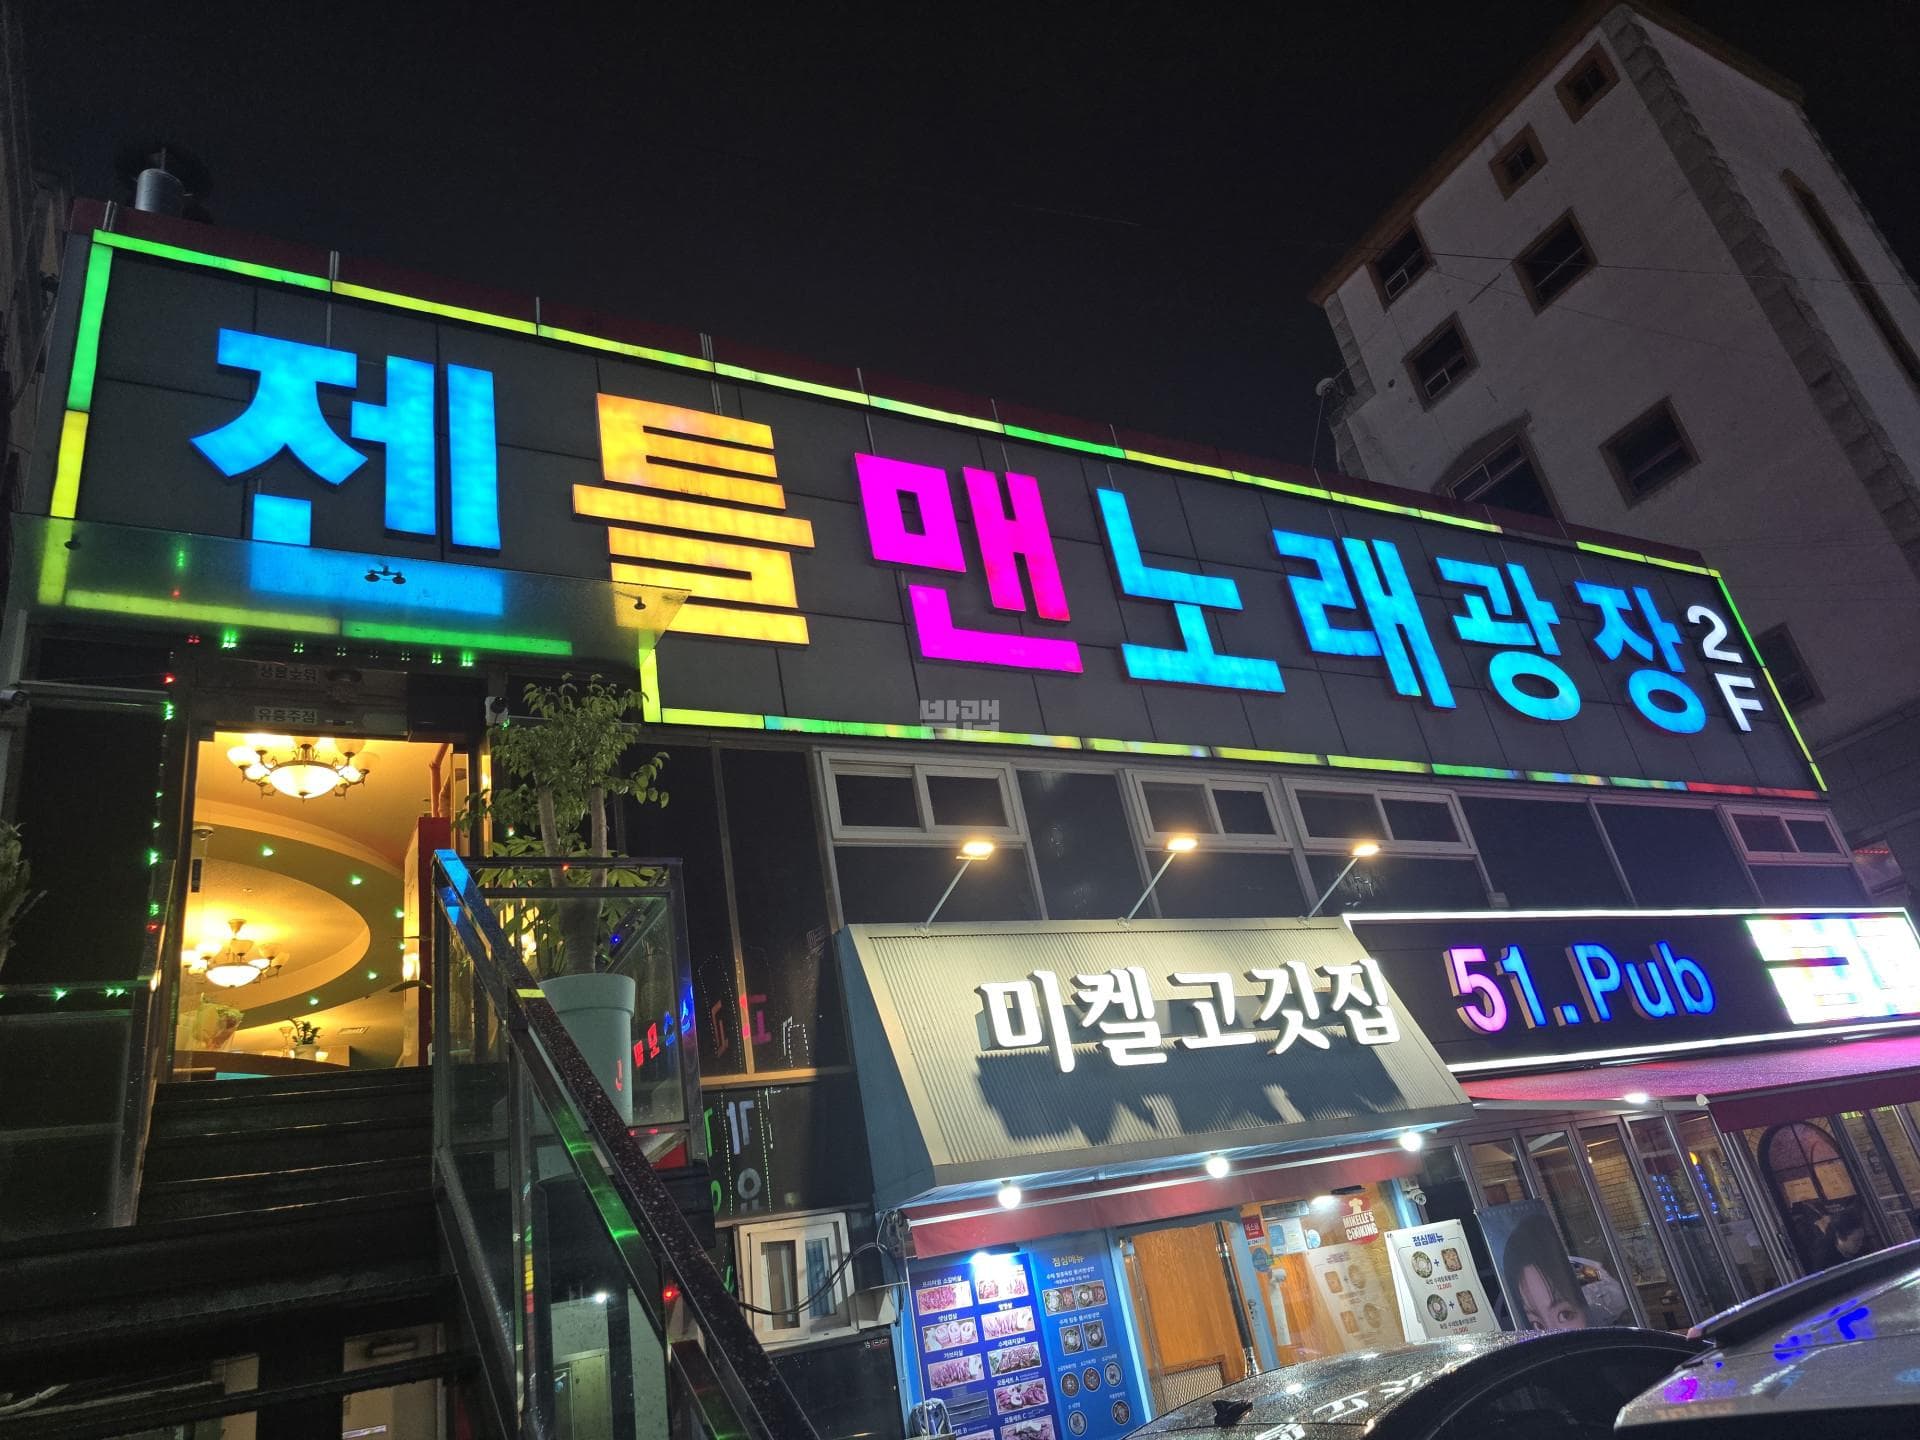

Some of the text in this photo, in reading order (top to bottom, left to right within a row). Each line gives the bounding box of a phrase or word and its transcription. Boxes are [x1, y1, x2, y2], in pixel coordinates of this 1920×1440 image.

[257, 708, 317, 724] 유흥주점
[1342, 1211, 1375, 1229] MIKELLE'S
[1345, 1222, 1379, 1241] COOKING
[1412, 1232, 1445, 1248] 점심메뉴
[1052, 1255, 1085, 1267] 점심메뉴
